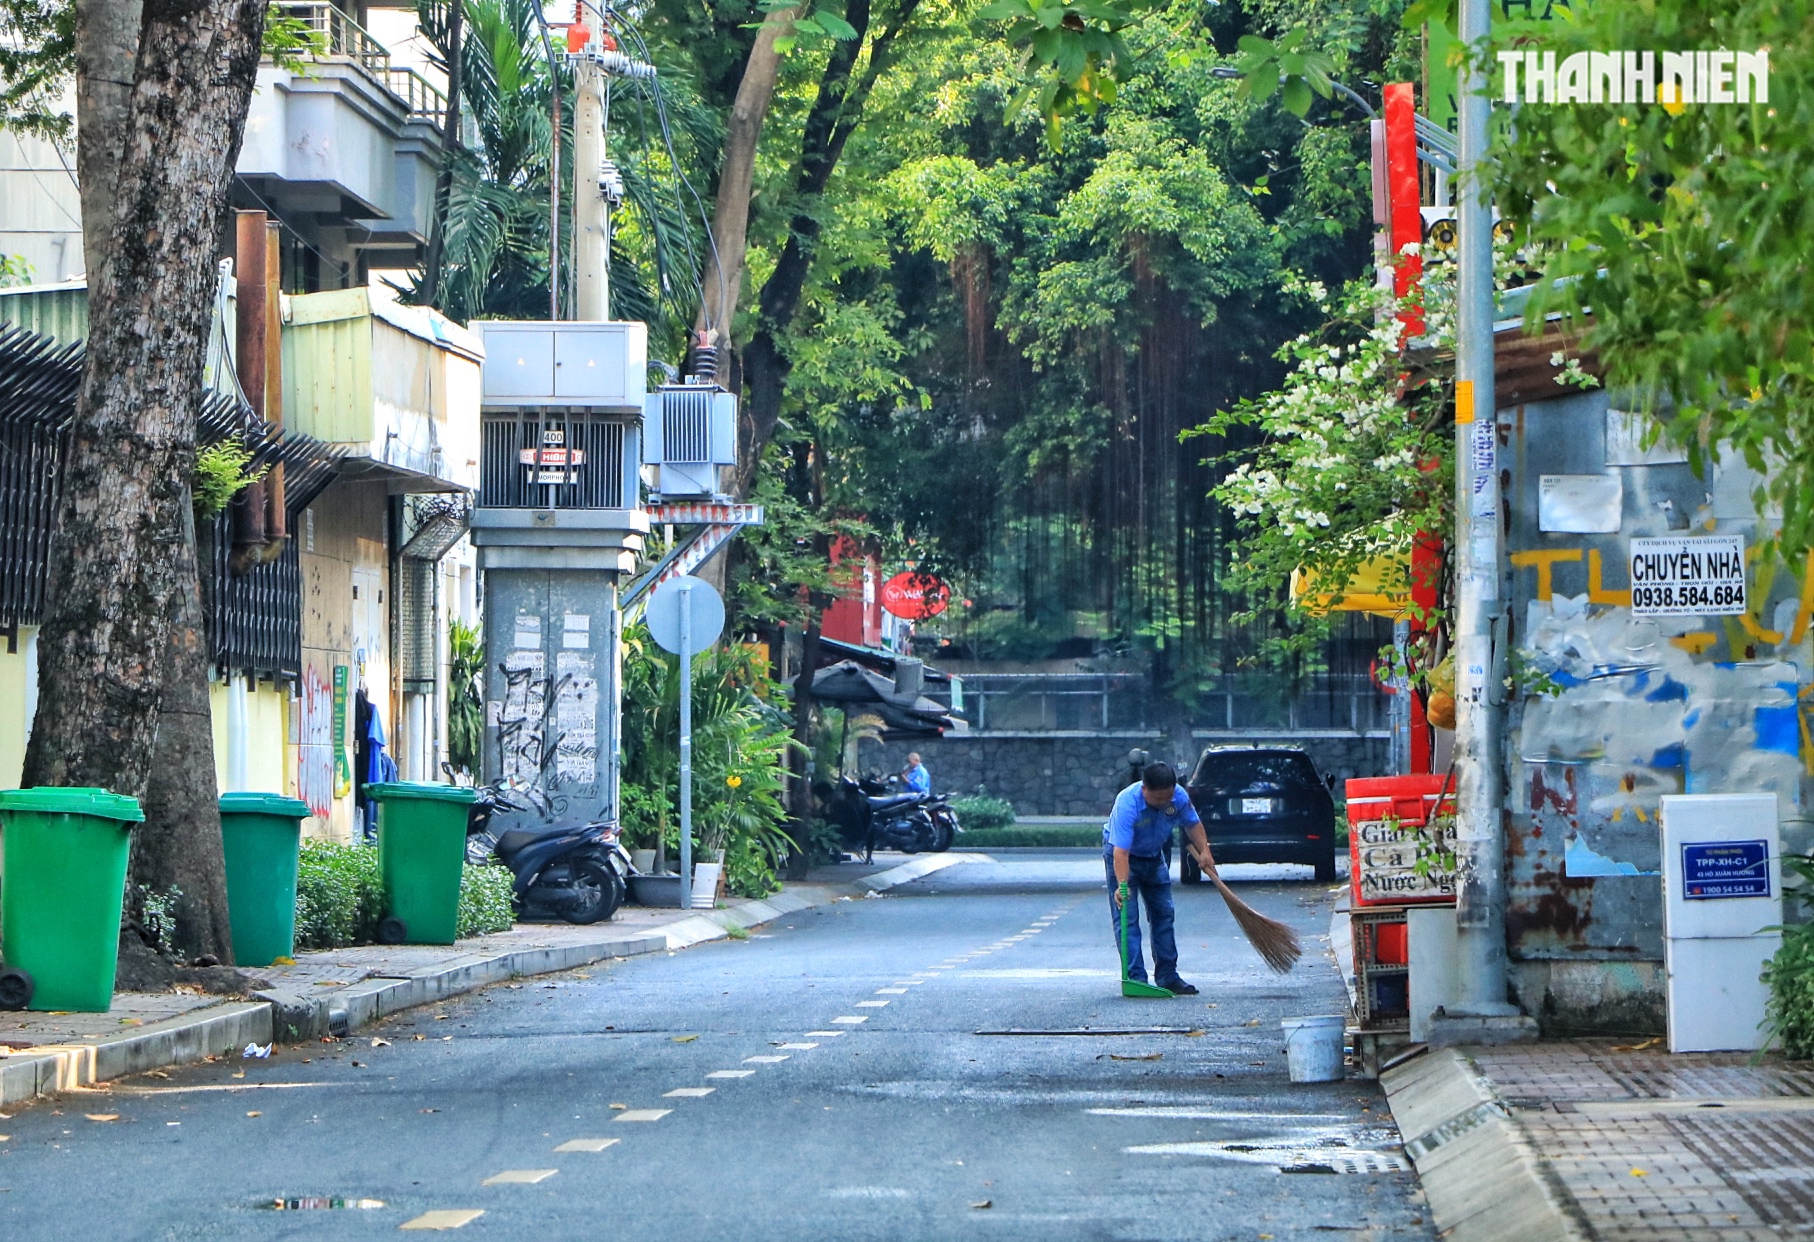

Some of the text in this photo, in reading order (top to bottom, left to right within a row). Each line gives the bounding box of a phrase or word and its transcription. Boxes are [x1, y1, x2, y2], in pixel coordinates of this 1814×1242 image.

[544, 432, 563, 442] 400
[1633, 546, 1743, 581] CHUYỂN NHÀ
[1633, 585, 1744, 607] 0938.584.684
[1365, 848, 1404, 868] Cà
[1696, 857, 1747, 867] TPP-XH-C1
[1362, 871, 1417, 892] Nước
[1703, 886, 1722, 894] 1900
[1733, 885, 1744, 893] 54
[1745, 884, 1755, 892] 54
